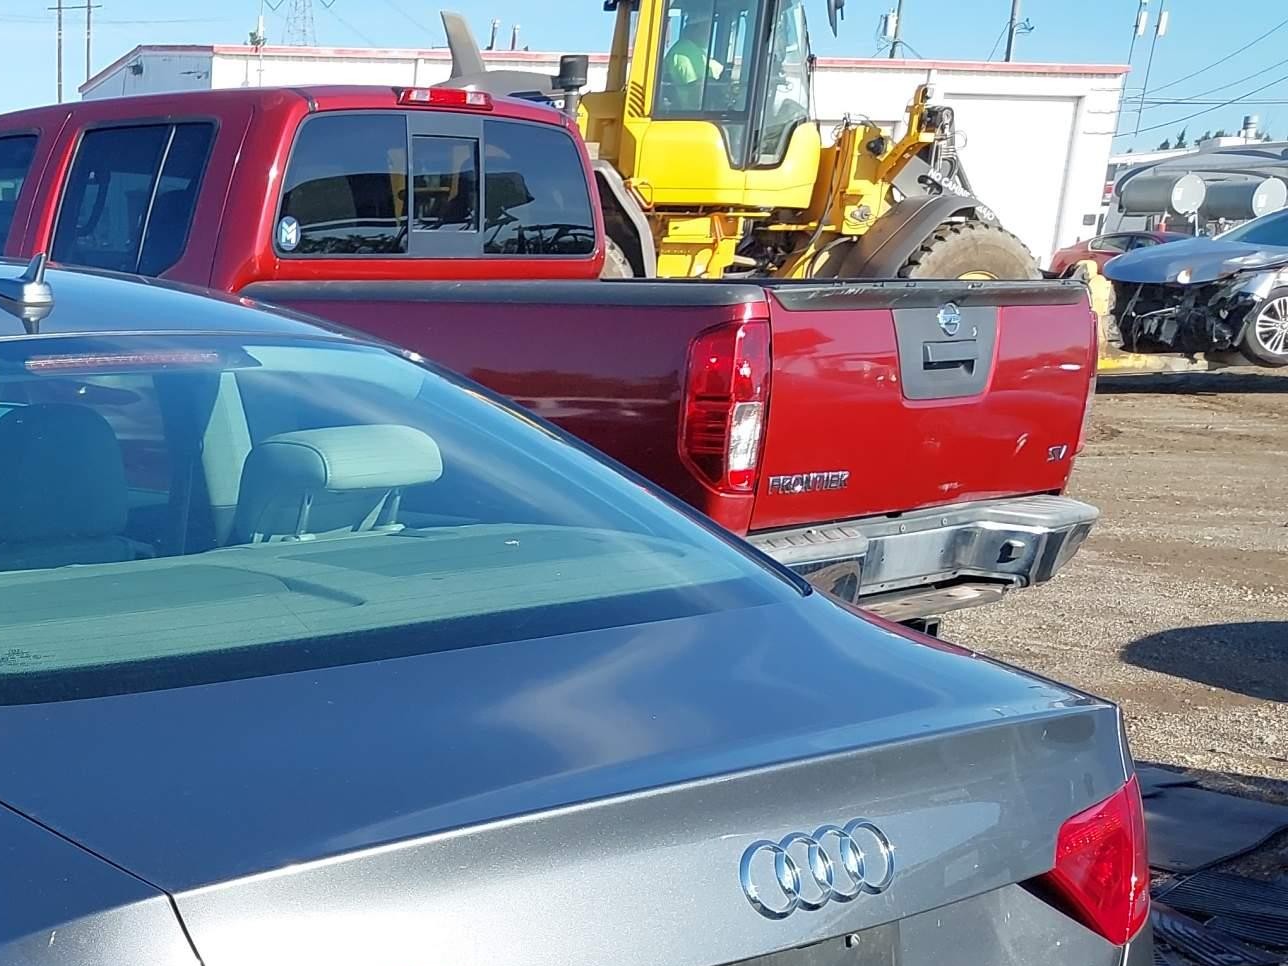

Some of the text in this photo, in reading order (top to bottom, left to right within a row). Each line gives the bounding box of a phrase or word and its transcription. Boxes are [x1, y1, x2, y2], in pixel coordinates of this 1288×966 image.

[928, 167, 943, 181] NO
[1047, 444, 1068, 462] SV
[768, 470, 850, 496] FRONTIER
